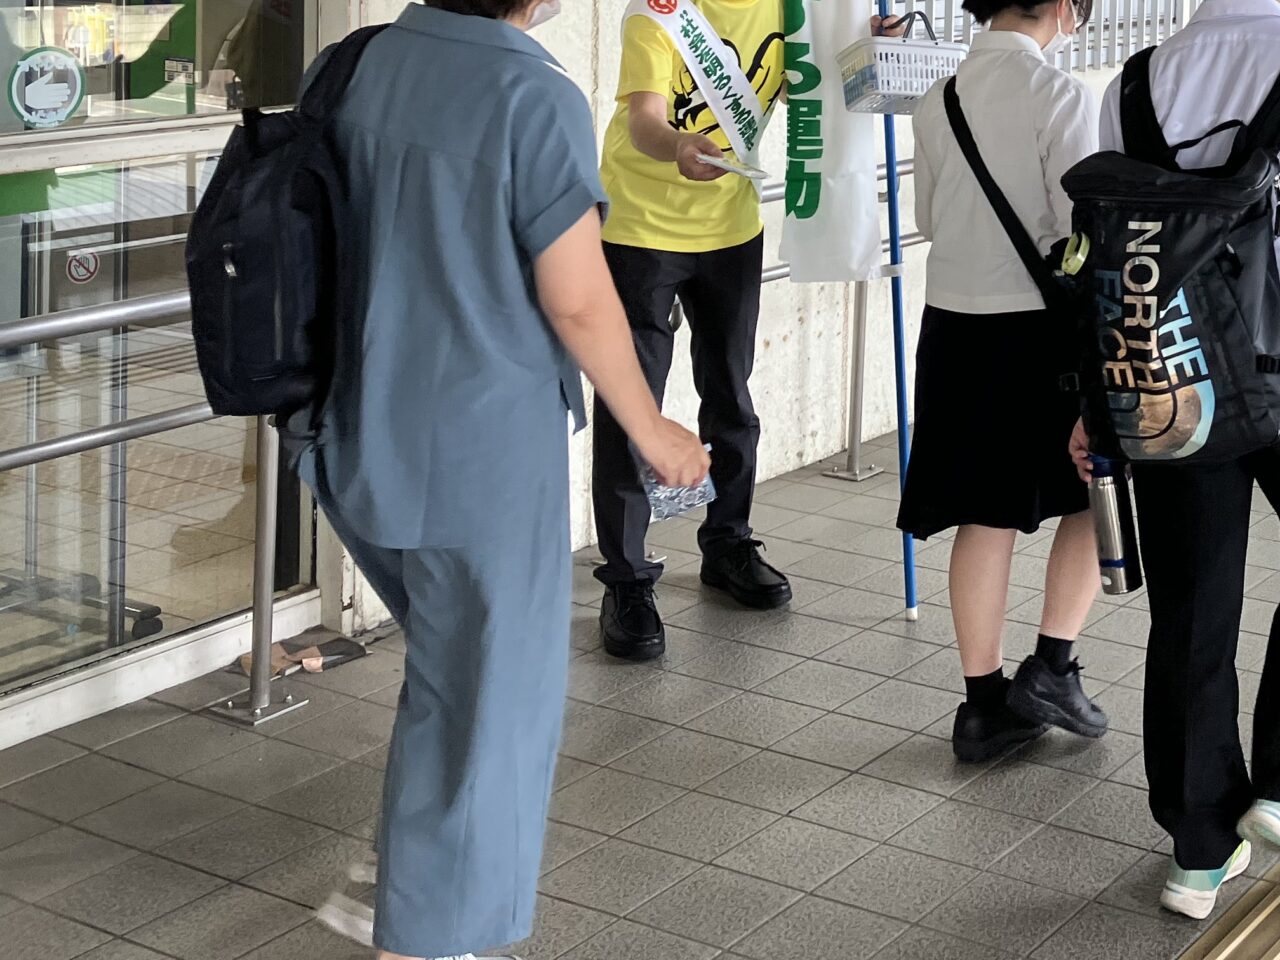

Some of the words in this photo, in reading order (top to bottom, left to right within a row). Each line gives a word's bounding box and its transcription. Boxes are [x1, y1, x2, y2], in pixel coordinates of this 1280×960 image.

[1096, 268, 1136, 390] FACE
[1122, 220, 1169, 391] NORTH
[1159, 286, 1210, 387] THE
